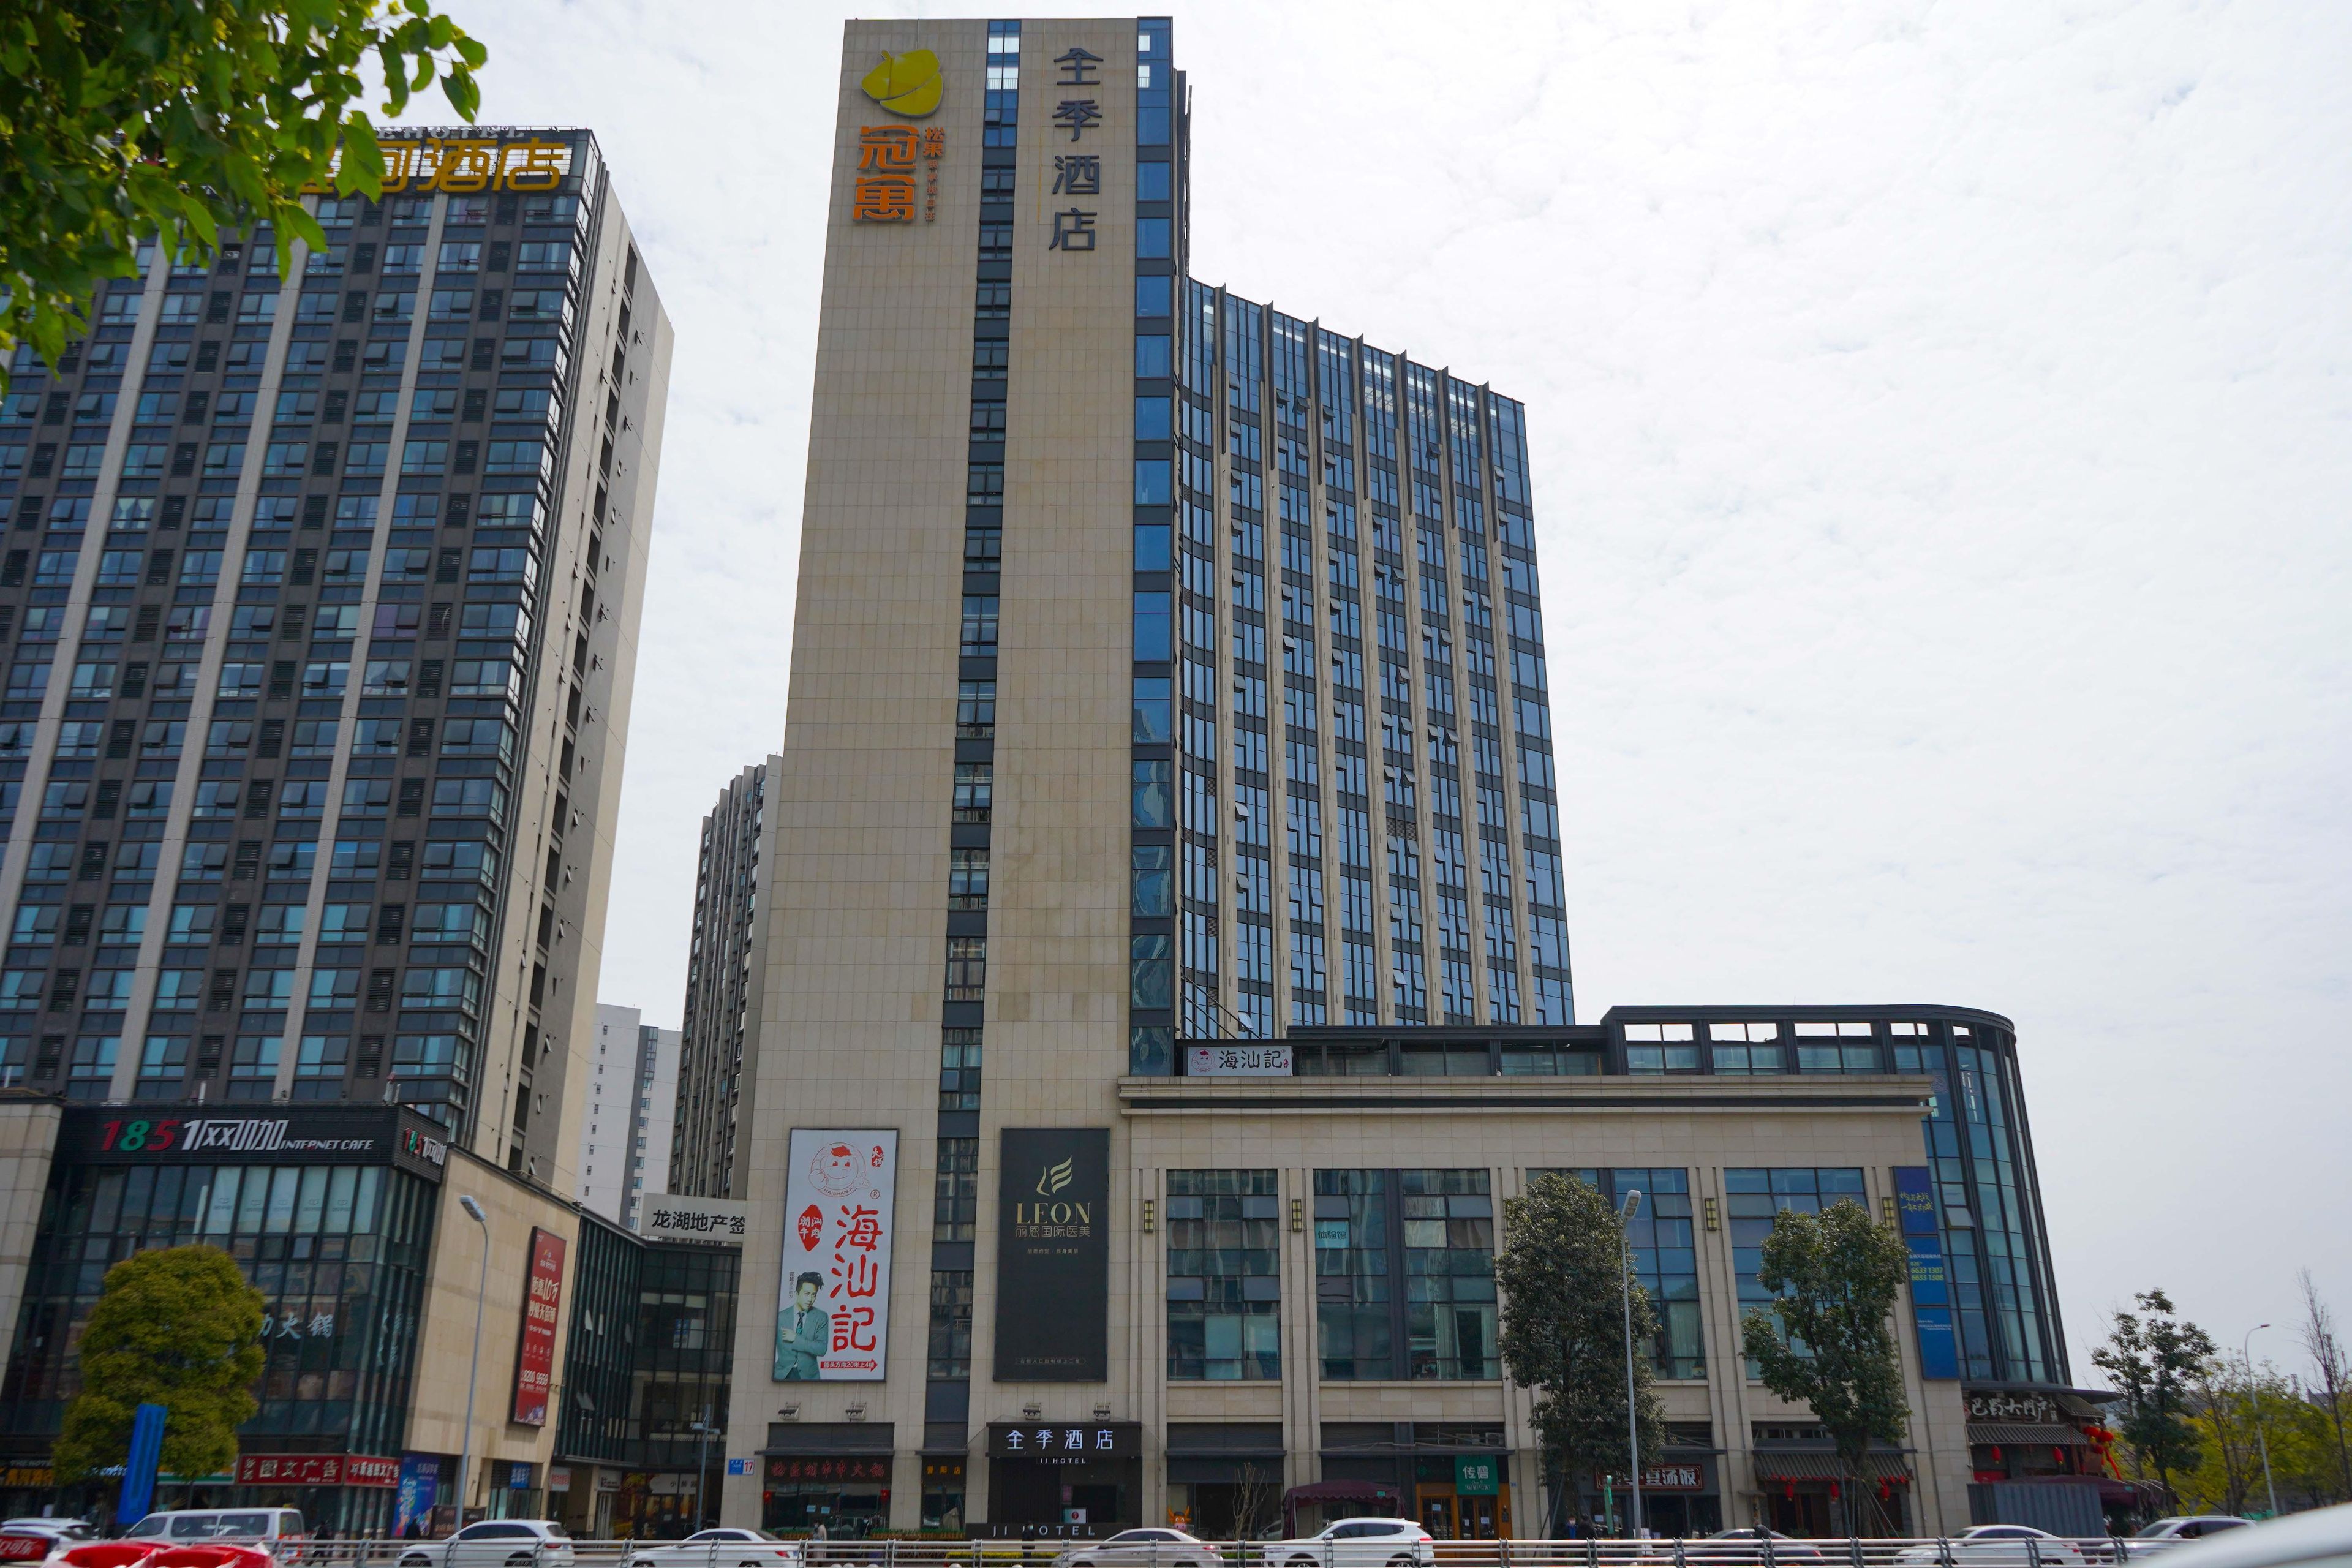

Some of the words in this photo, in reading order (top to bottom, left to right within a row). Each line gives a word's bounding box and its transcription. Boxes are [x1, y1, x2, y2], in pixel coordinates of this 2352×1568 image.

[923, 127, 945, 158] 松果
[1049, 47, 1104, 251] 全季酒店
[853, 124, 920, 222] 冠寓
[281, 1140, 341, 1150] INTERNET
[341, 1139, 374, 1150] CAFE
[1016, 1202, 1090, 1224] LEON
[1016, 1226, 1091, 1237] 丽恩国际医美
[1318, 1231, 1347, 1239] 体验馆
[1006, 1428, 1114, 1450] 全季酒店
[744, 1461, 753, 1472] 17
[1462, 1465, 1489, 1479] 传碧
[993, 1526, 1008, 1537] JI
